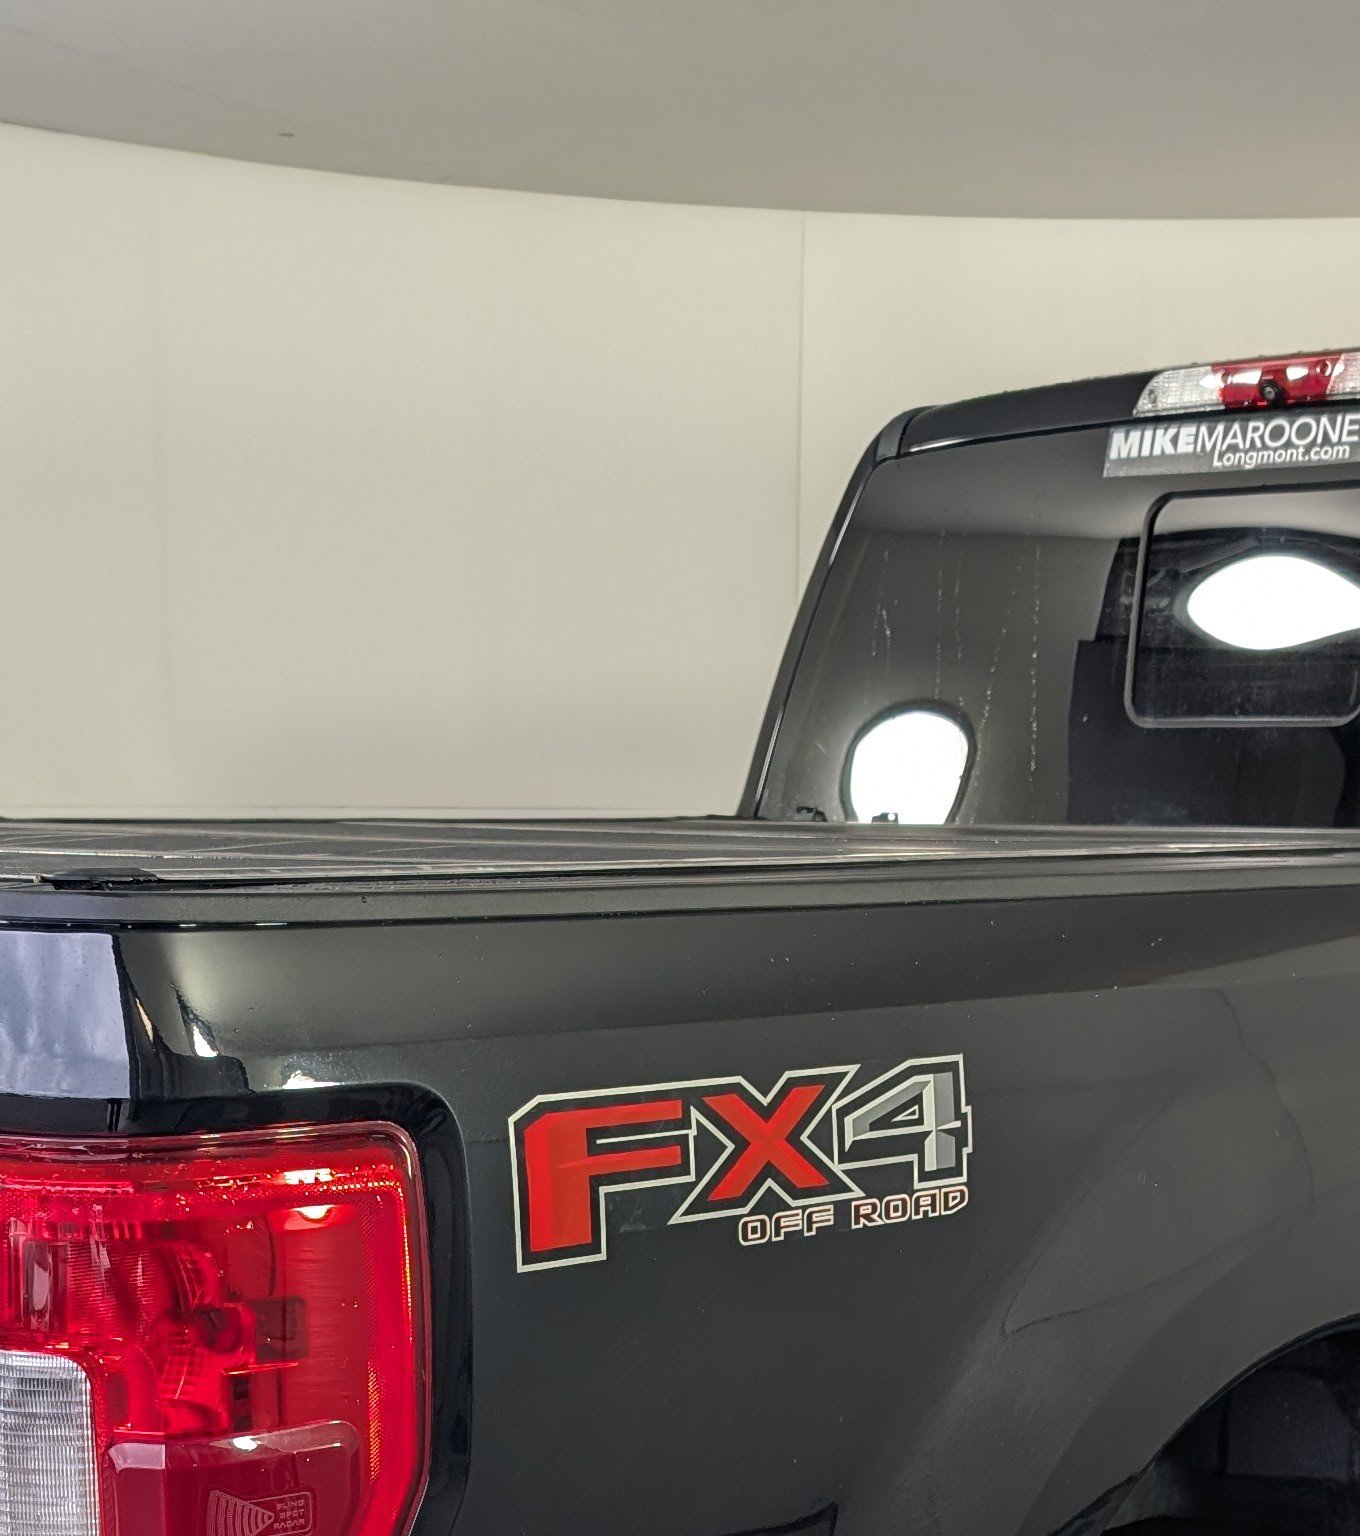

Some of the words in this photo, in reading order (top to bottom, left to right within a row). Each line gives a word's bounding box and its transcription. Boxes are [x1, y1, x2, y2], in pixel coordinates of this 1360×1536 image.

[1212, 443, 1350, 470] Longmont.com
[508, 1053, 973, 1274] FX4
[737, 1202, 835, 1246] OFF
[851, 1185, 970, 1231] ROAD
[273, 1519, 305, 1530] RADAR
[280, 1509, 305, 1519] SPOT
